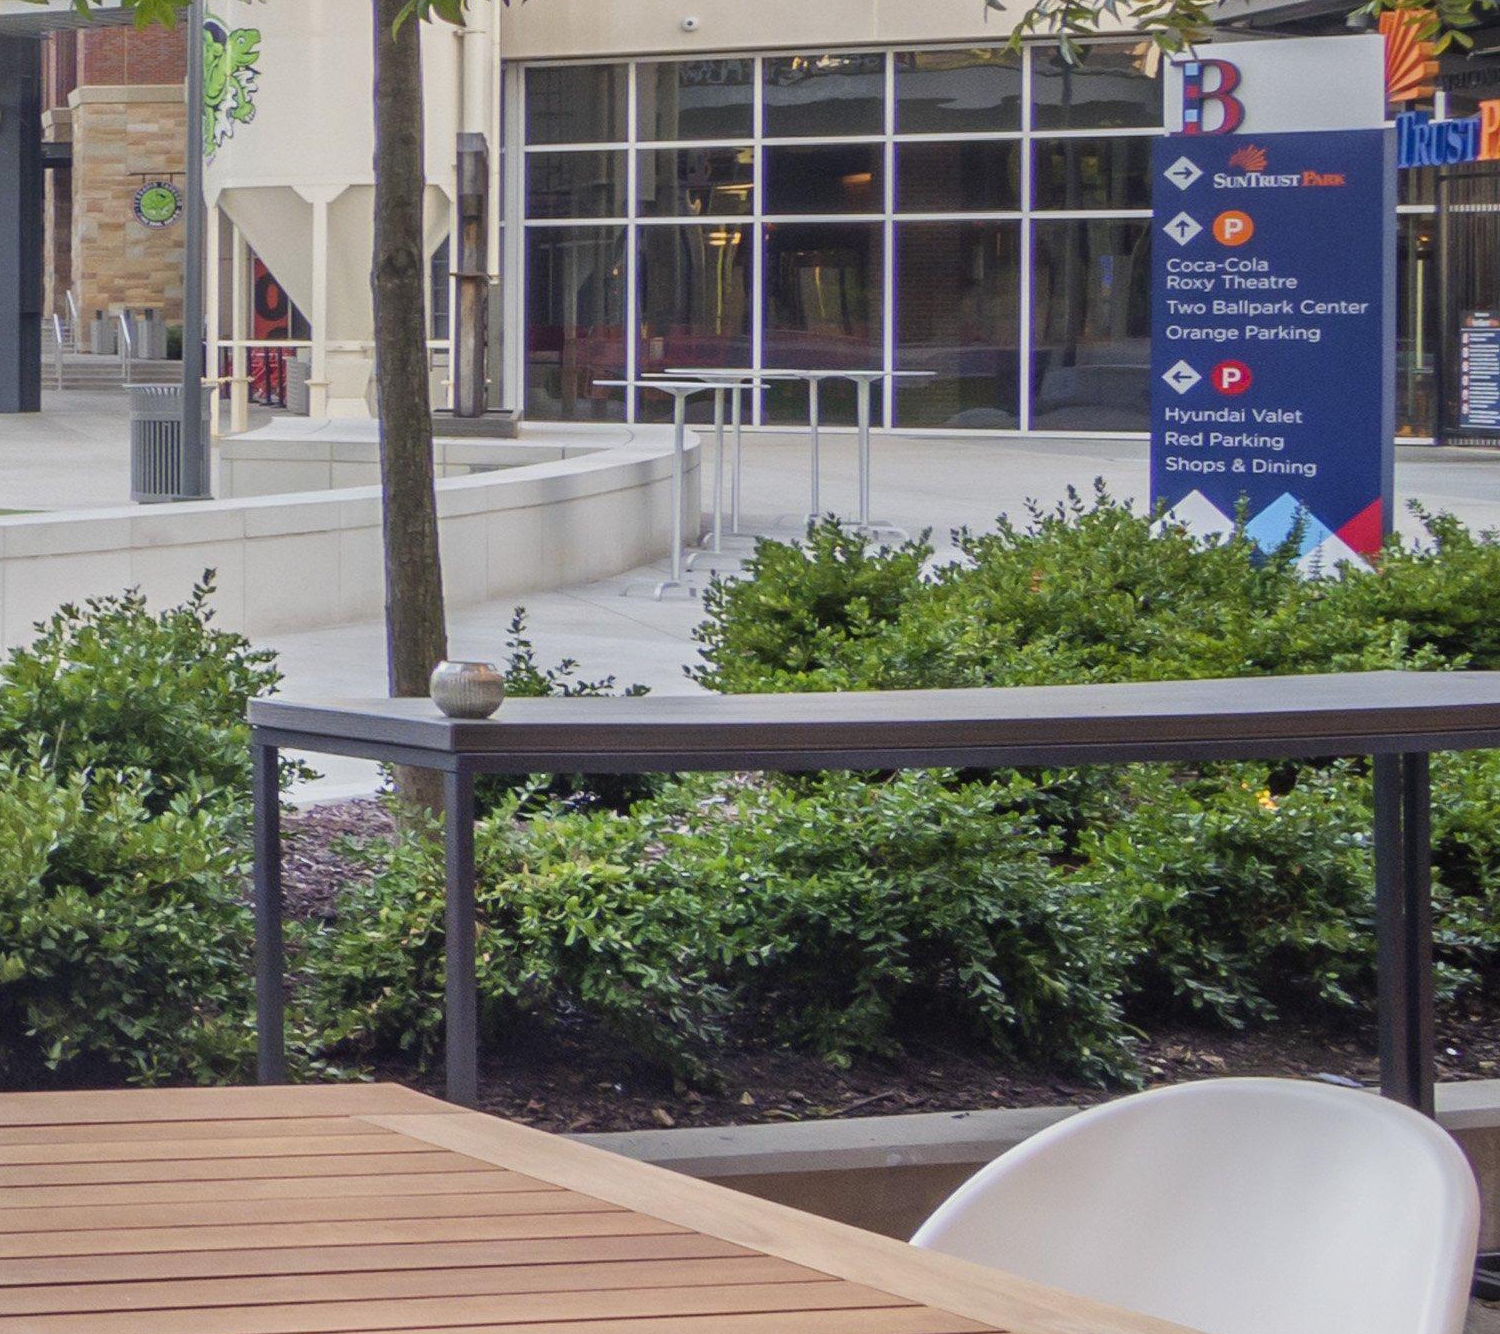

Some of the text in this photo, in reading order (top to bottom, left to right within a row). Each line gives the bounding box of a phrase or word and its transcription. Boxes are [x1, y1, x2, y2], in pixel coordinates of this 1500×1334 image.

[1171, 58, 1246, 136] B
[1223, 218, 1244, 239] P
[1166, 257, 1269, 273] Coca-Cola
[1166, 275, 1298, 293] Roxy Theatre
[1166, 299, 1369, 317] Two Ballpark Center
[1166, 325, 1322, 343] Orange Parking
[1221, 367, 1242, 388] P
[1165, 407, 1303, 424] Hyundai Valet
[1165, 432, 1285, 451] Red Parking
[1165, 456, 1318, 477] Shops & Dining
